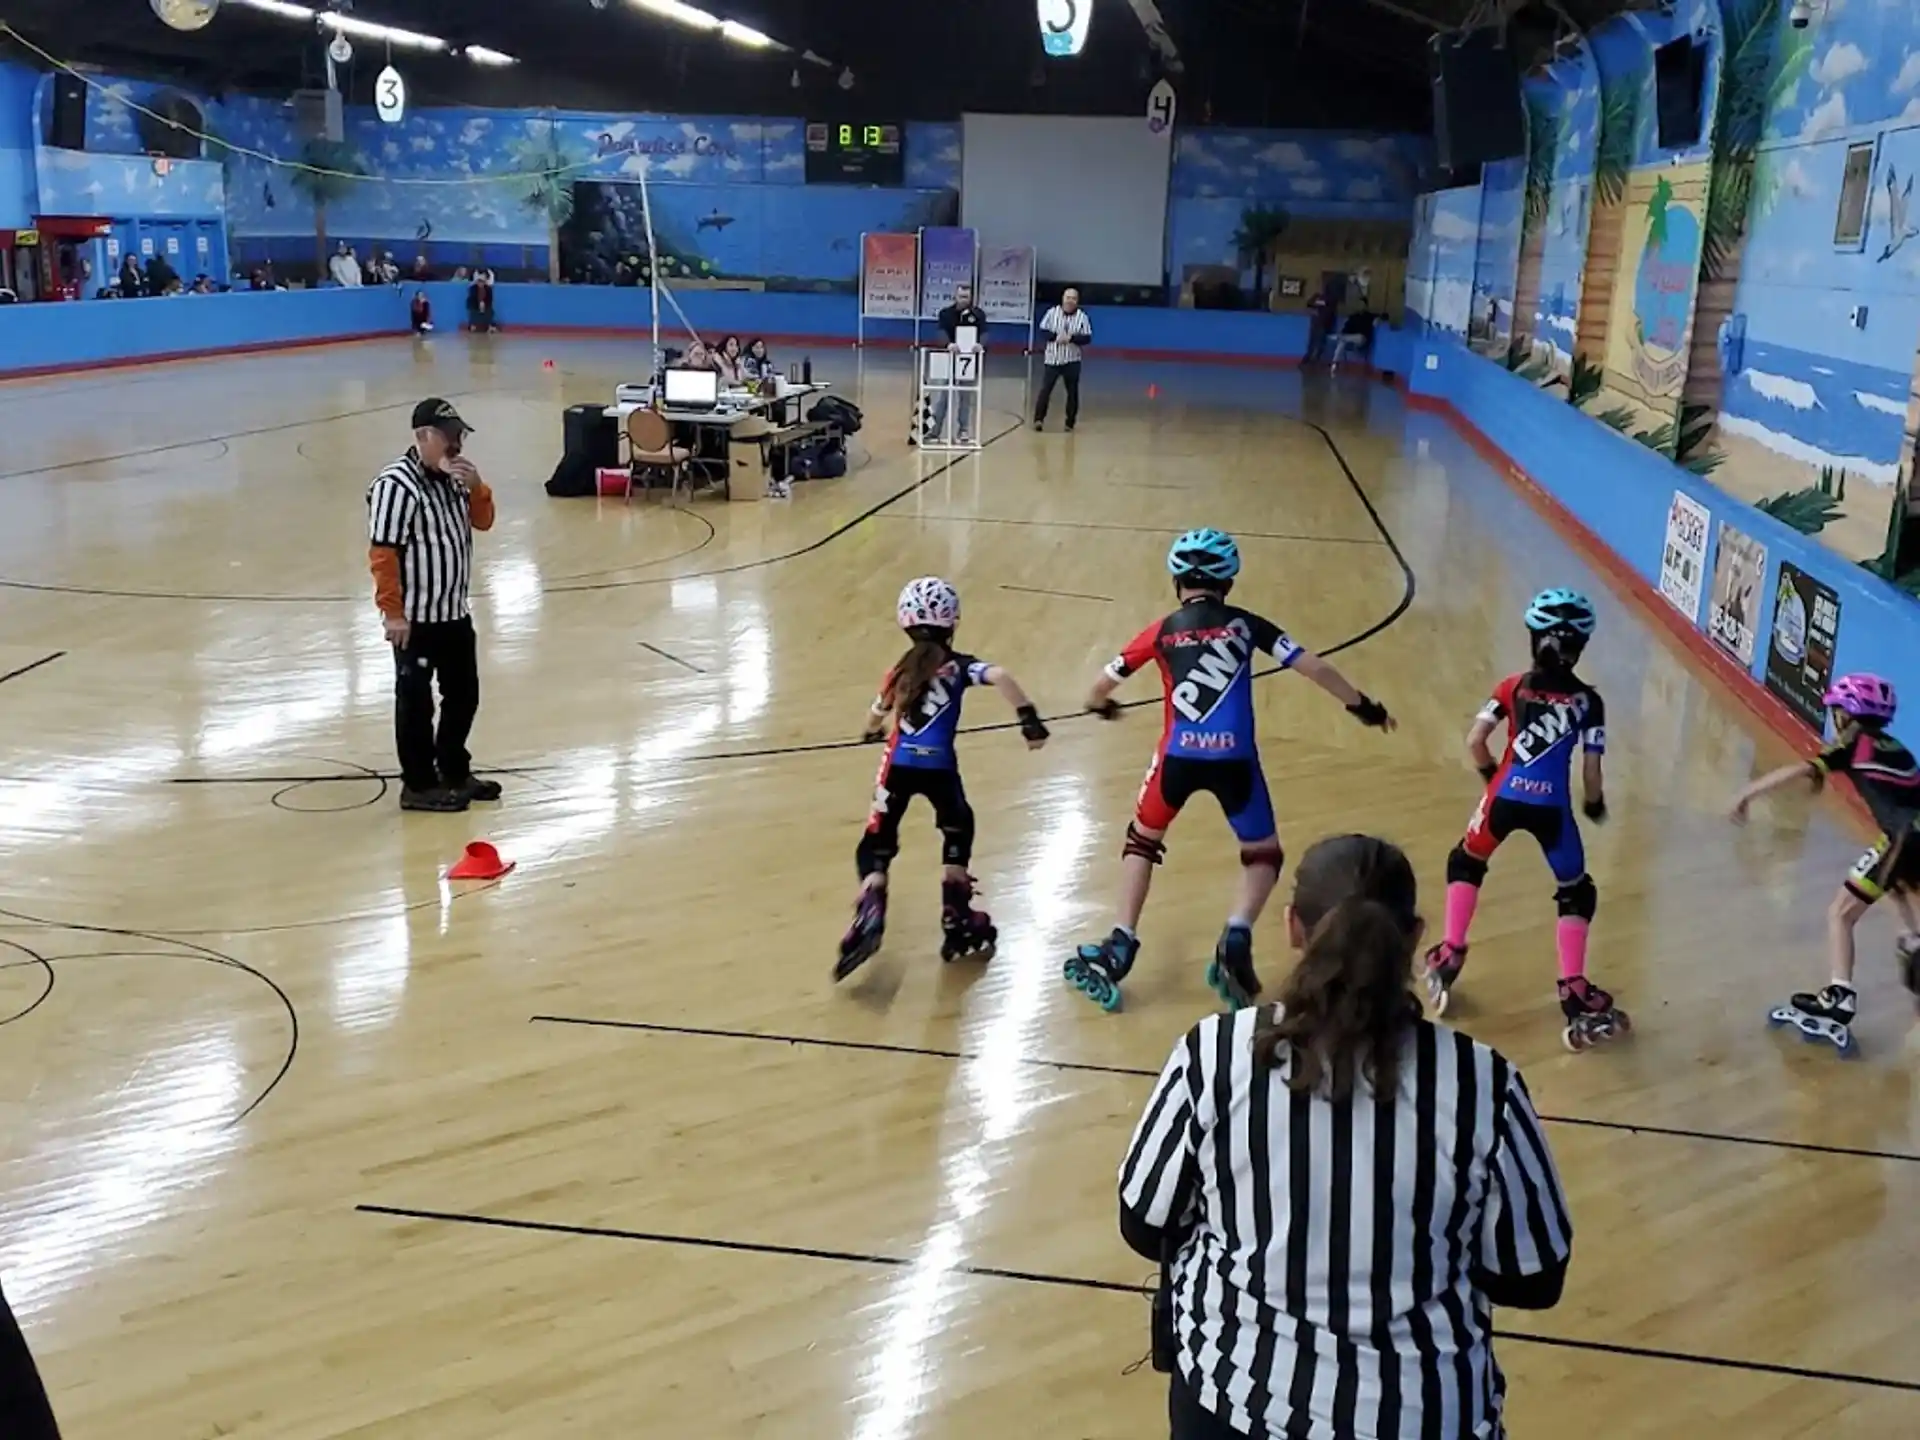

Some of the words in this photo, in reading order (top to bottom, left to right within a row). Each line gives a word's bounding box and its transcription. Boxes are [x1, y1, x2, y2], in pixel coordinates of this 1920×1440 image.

[380, 79, 399, 109] 3
[1154, 96, 1172, 126] 4
[840, 124, 852, 145] 8
[958, 357, 972, 377] 7
[1180, 731, 1235, 749] PWR
[1510, 775, 1554, 795] PWR
